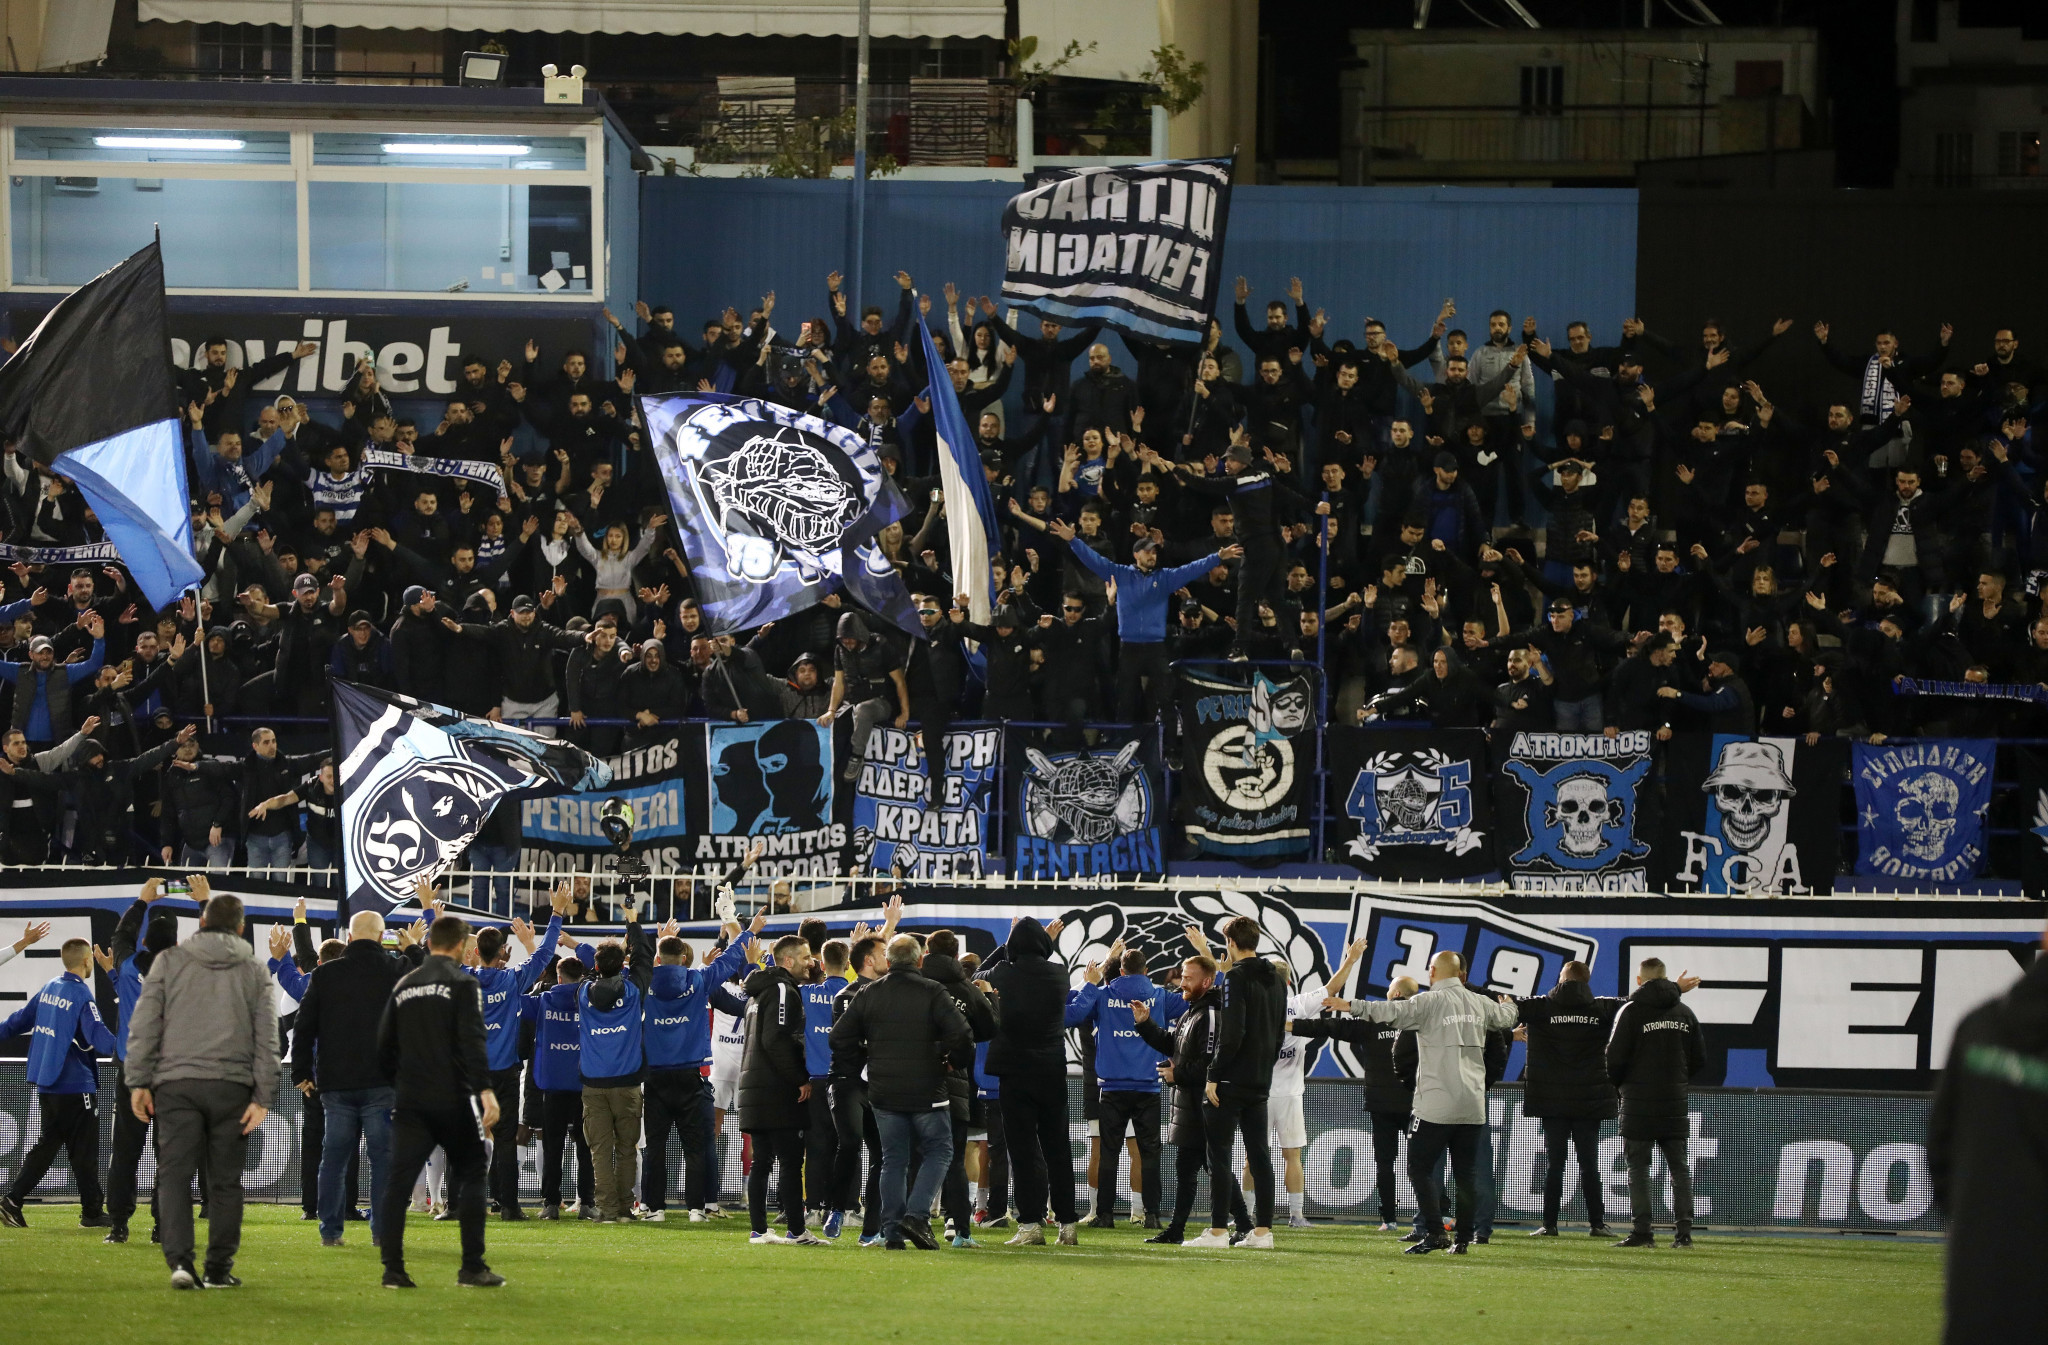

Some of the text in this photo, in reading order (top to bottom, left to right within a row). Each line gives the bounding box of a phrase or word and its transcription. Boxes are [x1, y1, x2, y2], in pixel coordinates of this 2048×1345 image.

[1510, 731, 1651, 760] ATROMITOS
[522, 789, 679, 837] PERISERI
[875, 804, 978, 846] ΚΡΑΤΑ
[695, 823, 847, 859] ATROMITOS
[1016, 829, 1163, 881] FENTAGIN
[518, 847, 681, 886] HOOLIGNS
[1513, 872, 1645, 897] FENTAGIN
[488, 991, 507, 1004] BOY
[545, 1010, 571, 1022] BALL
[654, 1016, 690, 1025] NOVA
[1550, 1015, 1588, 1025] ATROMITOS
[591, 1025, 627, 1035] NOVA
[1643, 1021, 1679, 1034] ATROMITOS
[718, 1035, 744, 1045] novi
